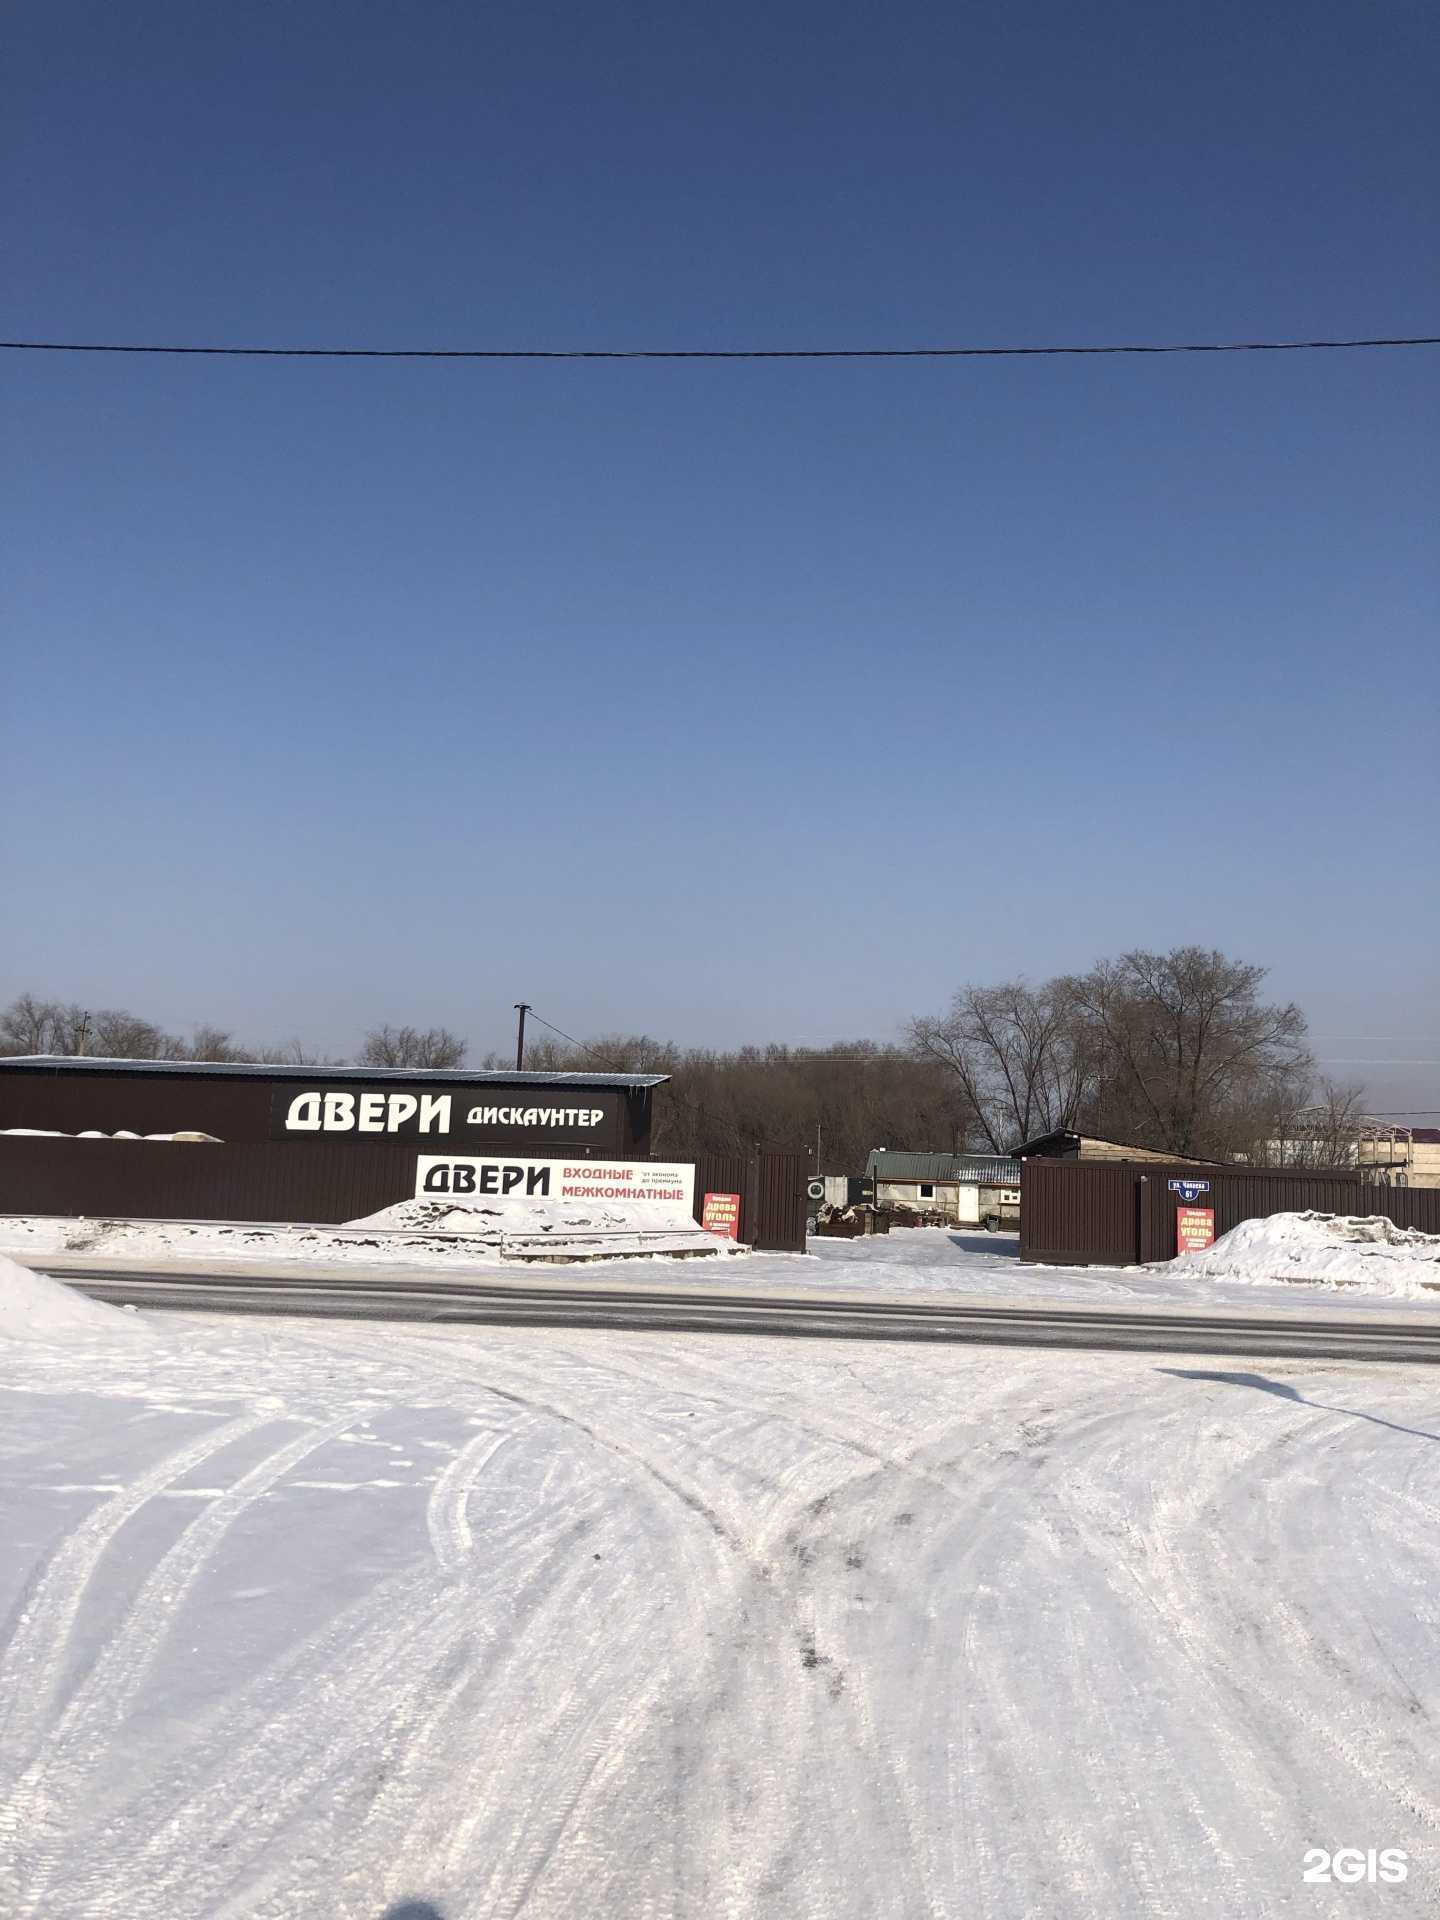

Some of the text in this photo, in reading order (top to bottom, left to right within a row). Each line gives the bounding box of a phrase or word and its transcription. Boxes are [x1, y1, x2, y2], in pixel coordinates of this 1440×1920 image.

[285, 1092, 604, 1133] ДВЕРИ ДИСКАУНТЕР
[423, 1164, 550, 1196] ДВЕРИ
[562, 1167, 634, 1181] ВХОДНЫЕ
[561, 1186, 685, 1200] МЕЖКОМНАТНЫЕ
